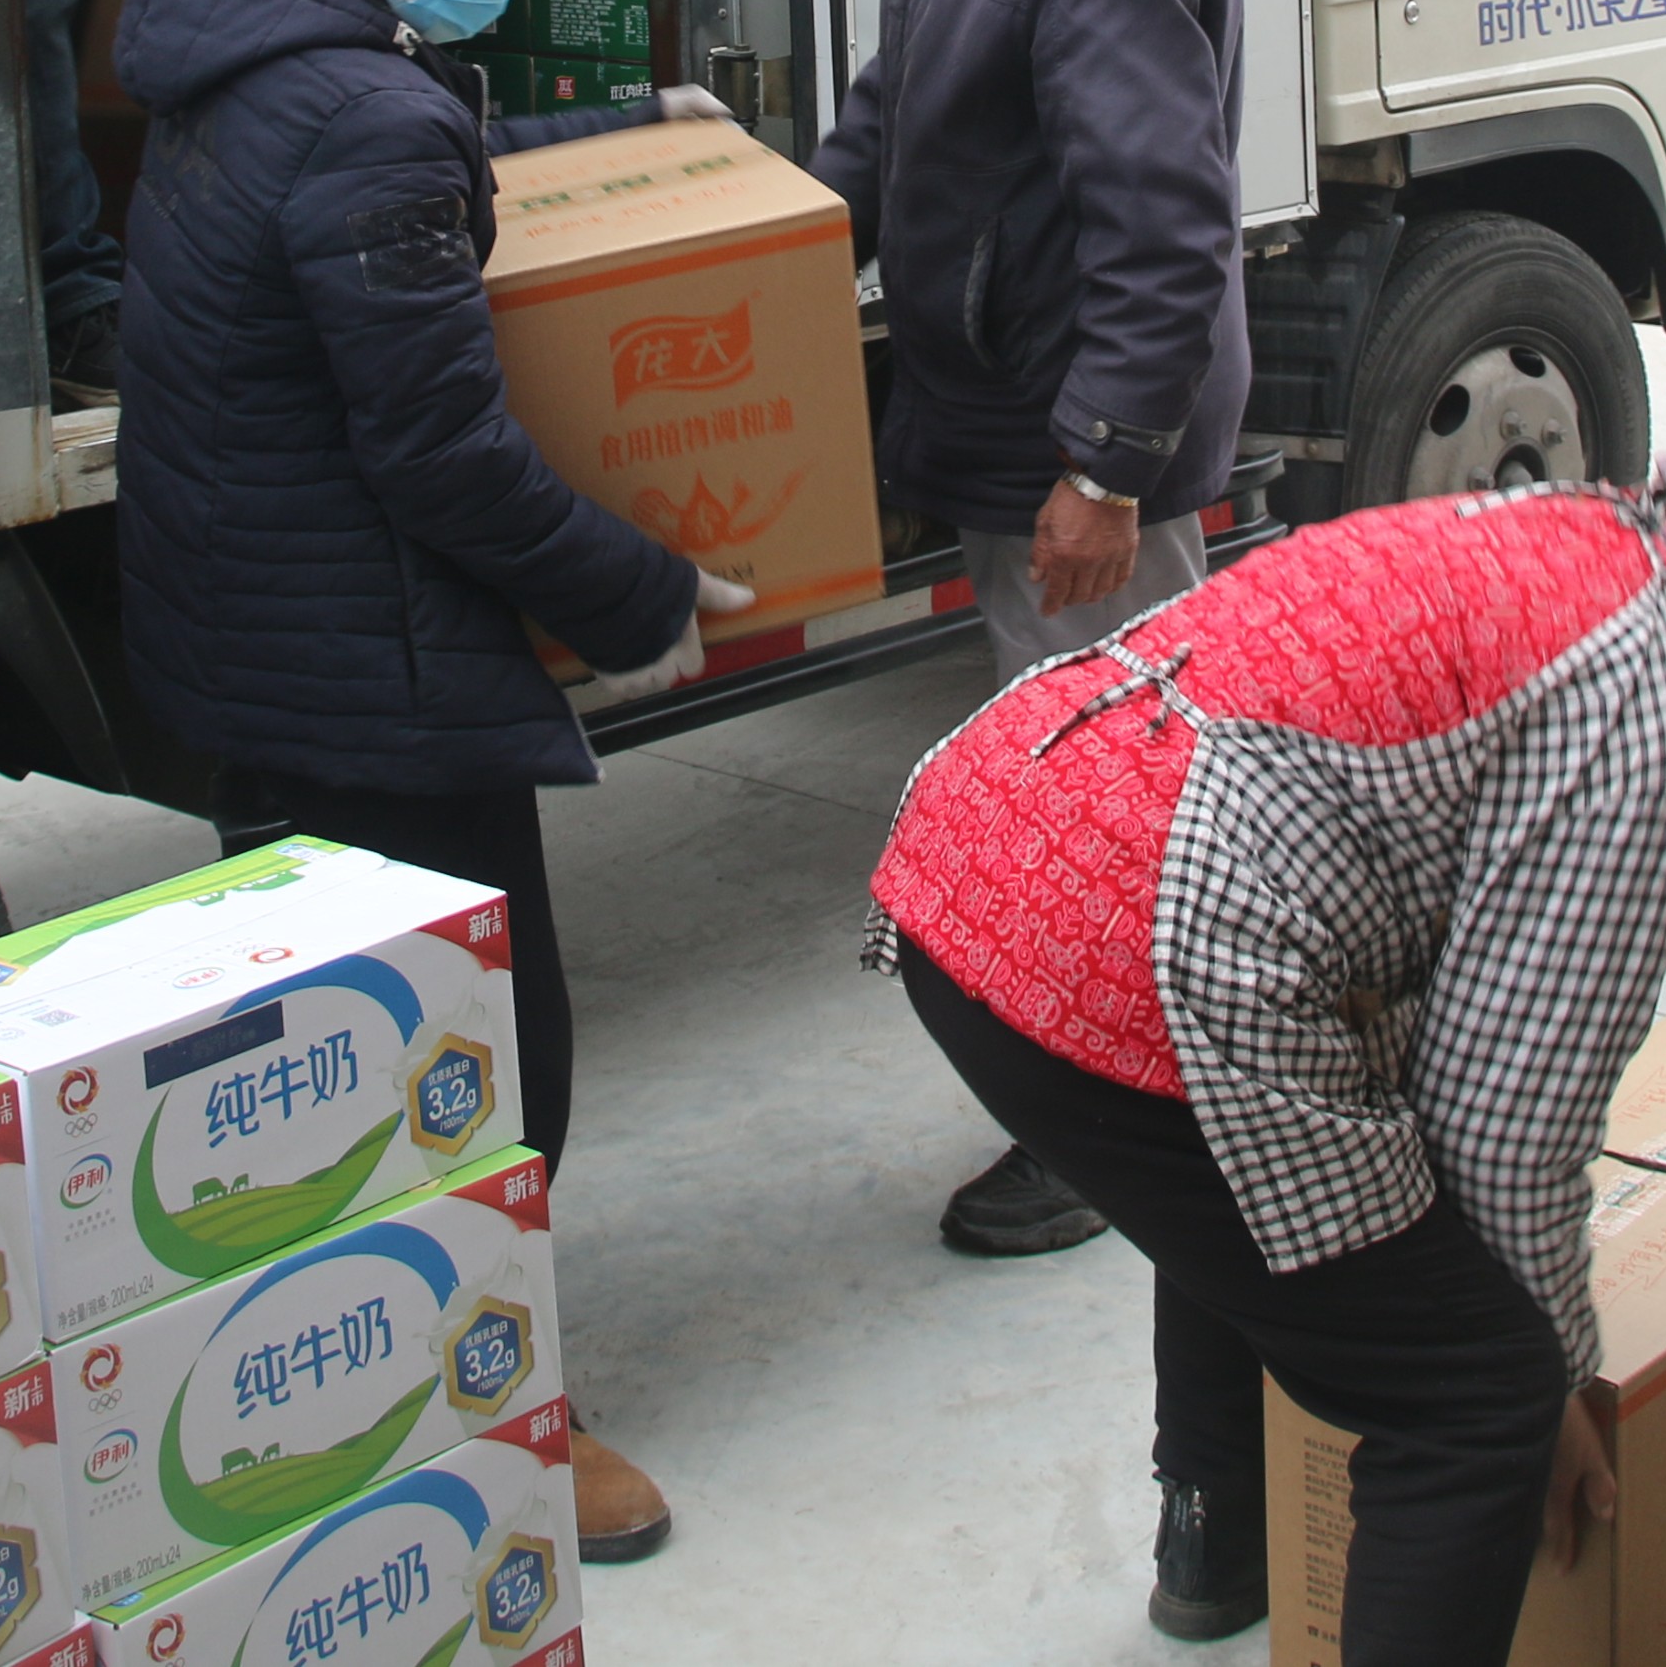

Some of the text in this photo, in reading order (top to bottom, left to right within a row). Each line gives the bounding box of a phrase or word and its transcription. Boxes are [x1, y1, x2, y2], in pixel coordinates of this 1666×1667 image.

[634, 328, 733, 383] 龙大
[601, 395, 795, 472] 食用植物调和油
[205, 1028, 358, 1148] 纯牛奶
[428, 1059, 470, 1087] 优质乳蛋白
[428, 1078, 476, 1122] 3.2g
[439, 1114, 467, 1132] /100mL
[67, 1165, 104, 1197] 伊利
[464, 1320, 508, 1348] 优质乳蛋白
[234, 1296, 392, 1419] 纯牛奶
[465, 1338, 515, 1383] 3.2g
[91, 1440, 130, 1473] 伊利
[494, 1556, 534, 1586] 优质乳蛋白
[285, 1542, 431, 1667] 纯牛奶
[494, 1576, 541, 1620] 3.2g
